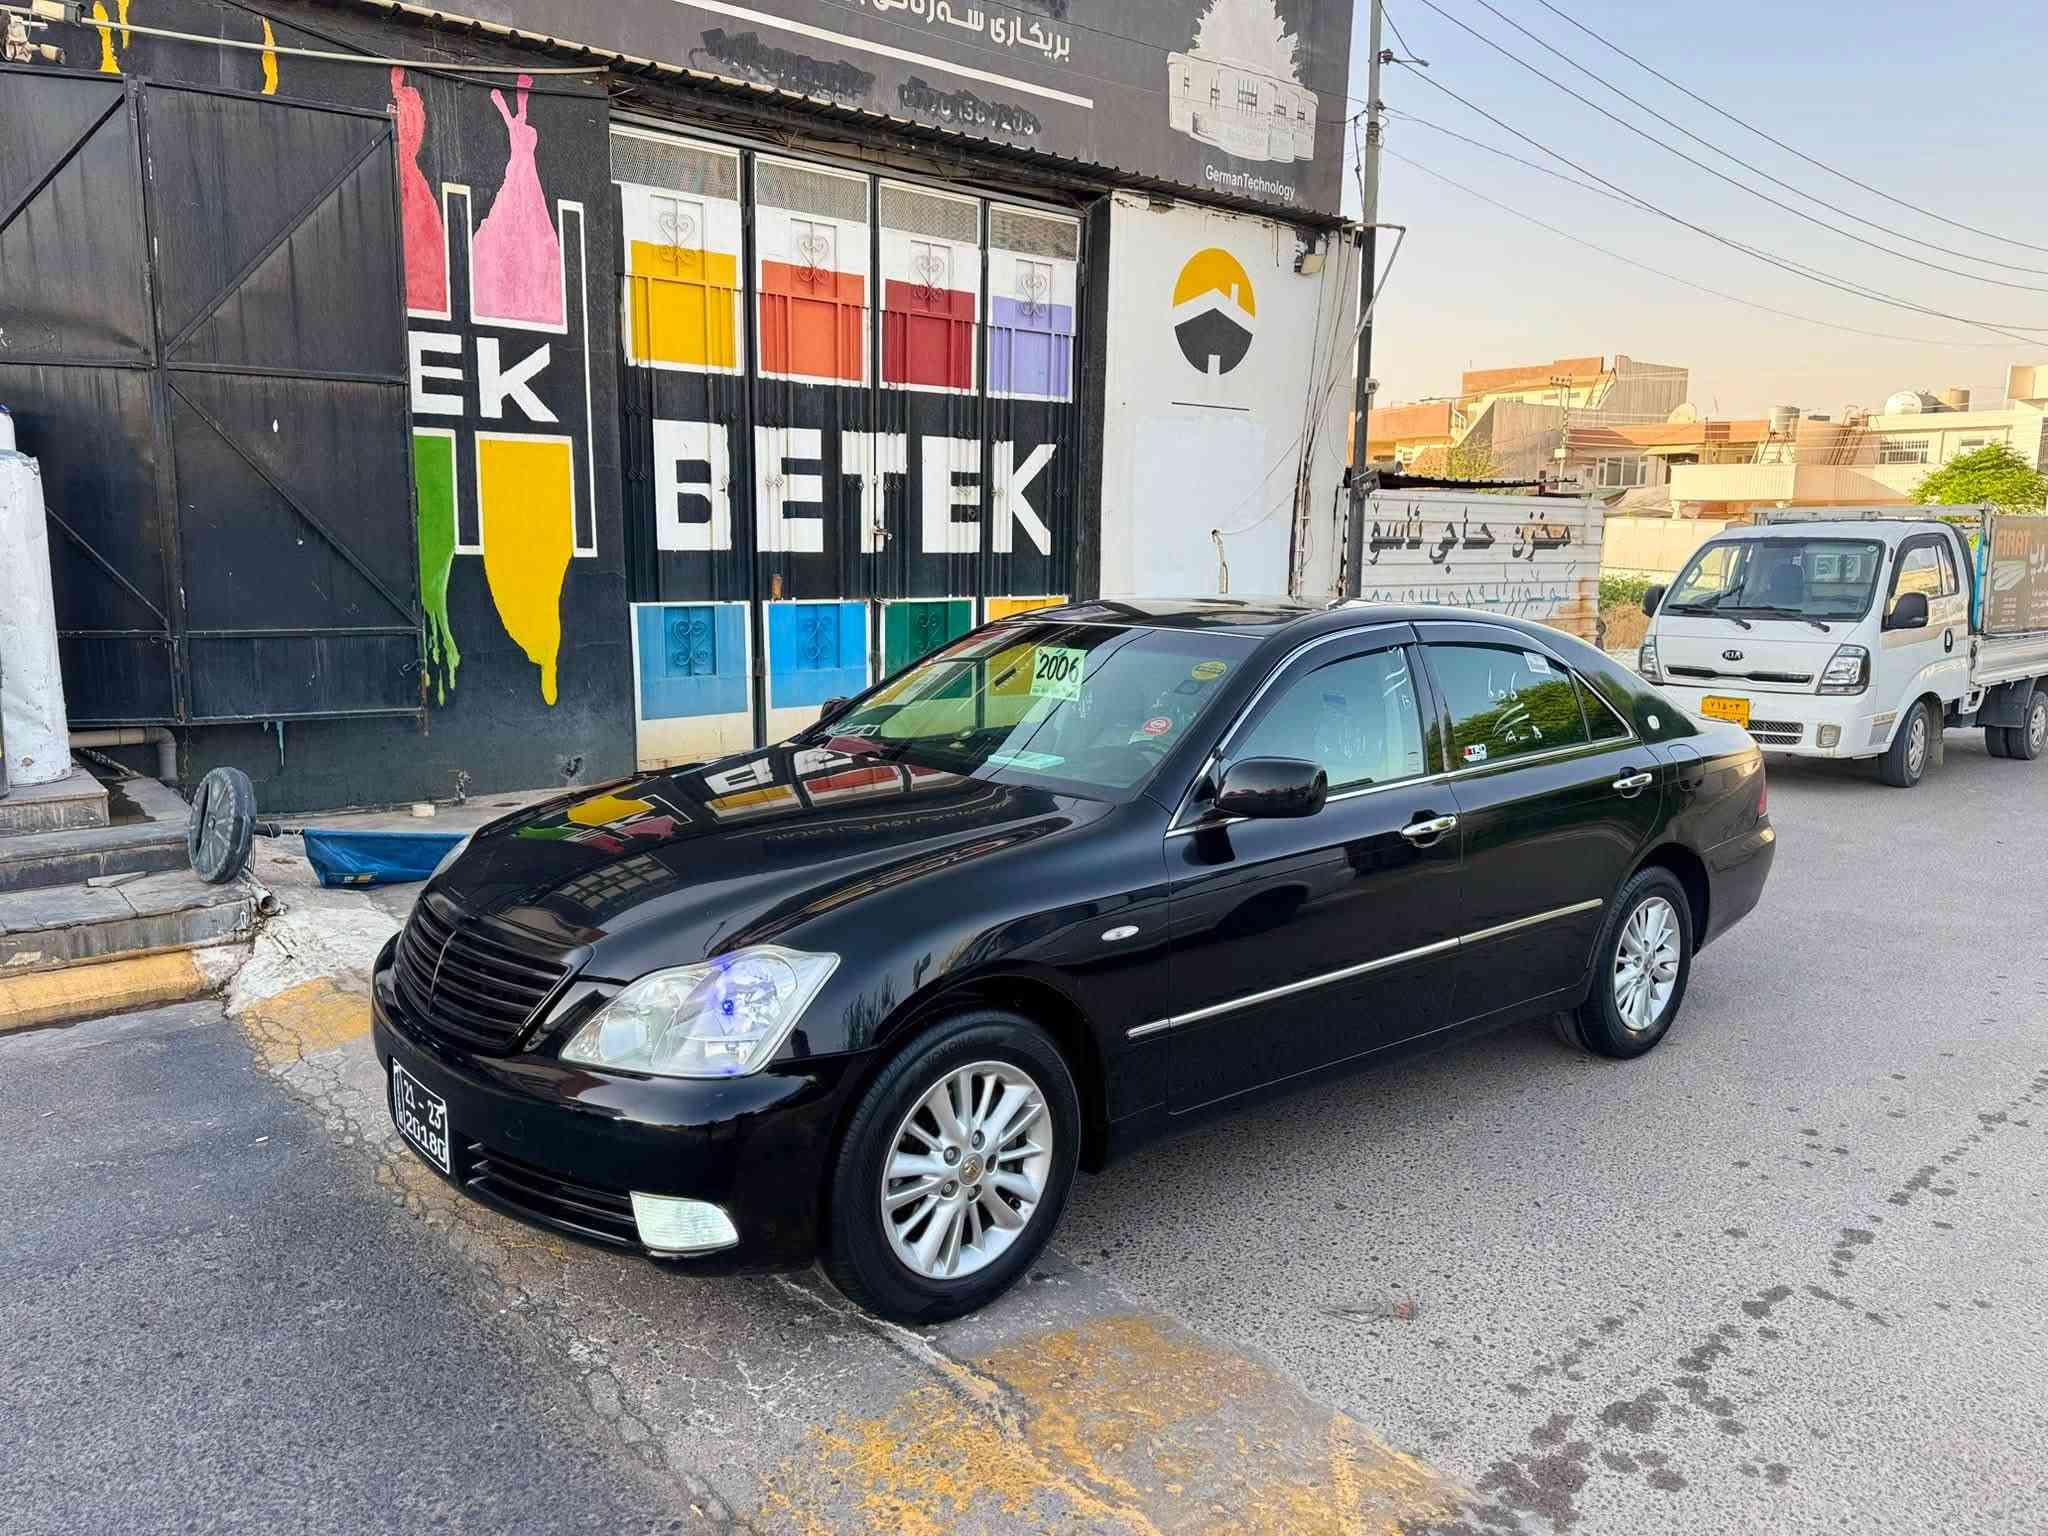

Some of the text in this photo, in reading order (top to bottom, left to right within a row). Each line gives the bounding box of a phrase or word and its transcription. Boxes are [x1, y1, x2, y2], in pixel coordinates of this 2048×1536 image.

[1205, 164, 1296, 201] GermanTechnology
[652, 418, 1057, 556] BETEK
[1036, 653, 1080, 684] 2006
